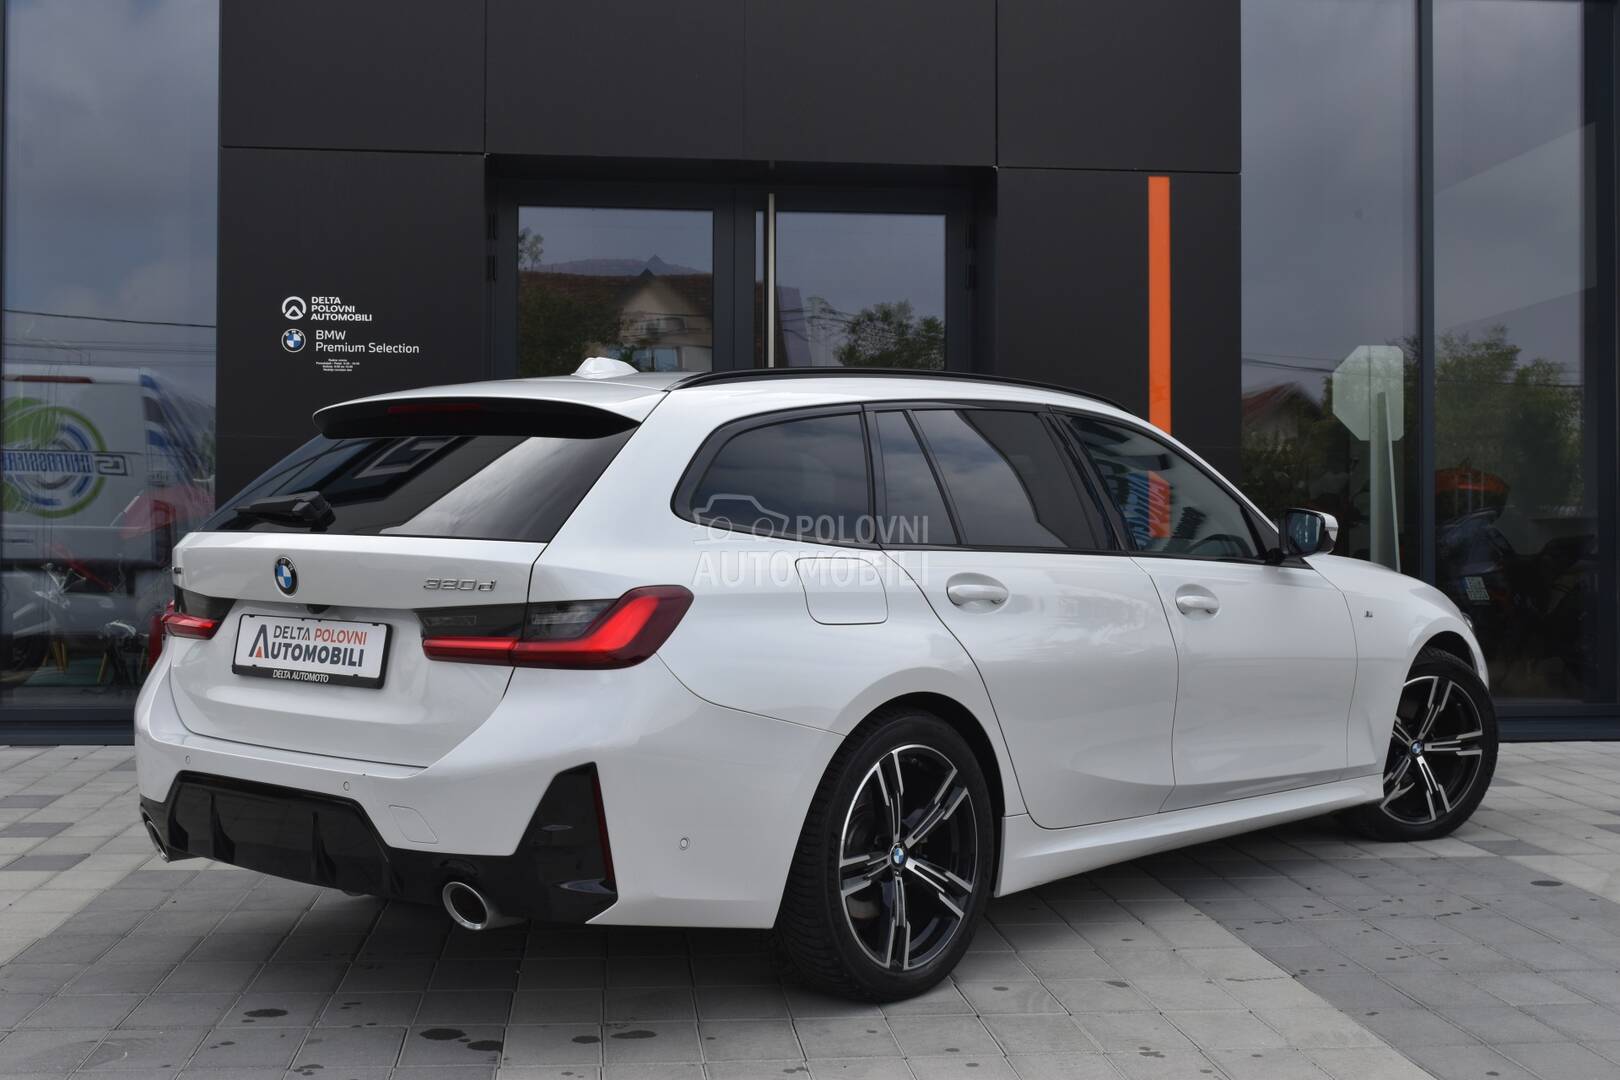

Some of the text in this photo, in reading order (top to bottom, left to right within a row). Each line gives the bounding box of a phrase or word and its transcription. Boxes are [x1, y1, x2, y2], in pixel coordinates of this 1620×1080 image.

[311, 296, 341, 304] DELTA
[310, 313, 372, 321] AUTOMOBILI
[316, 330, 346, 340] BMW
[316, 342, 420, 353] Premium Selection
[423, 578, 496, 591] 320d
[273, 625, 367, 645] DELTA POLOVNI
[248, 624, 365, 667] AUTOMOBILI
[272, 669, 329, 683] DELTA AUTOMOTO
